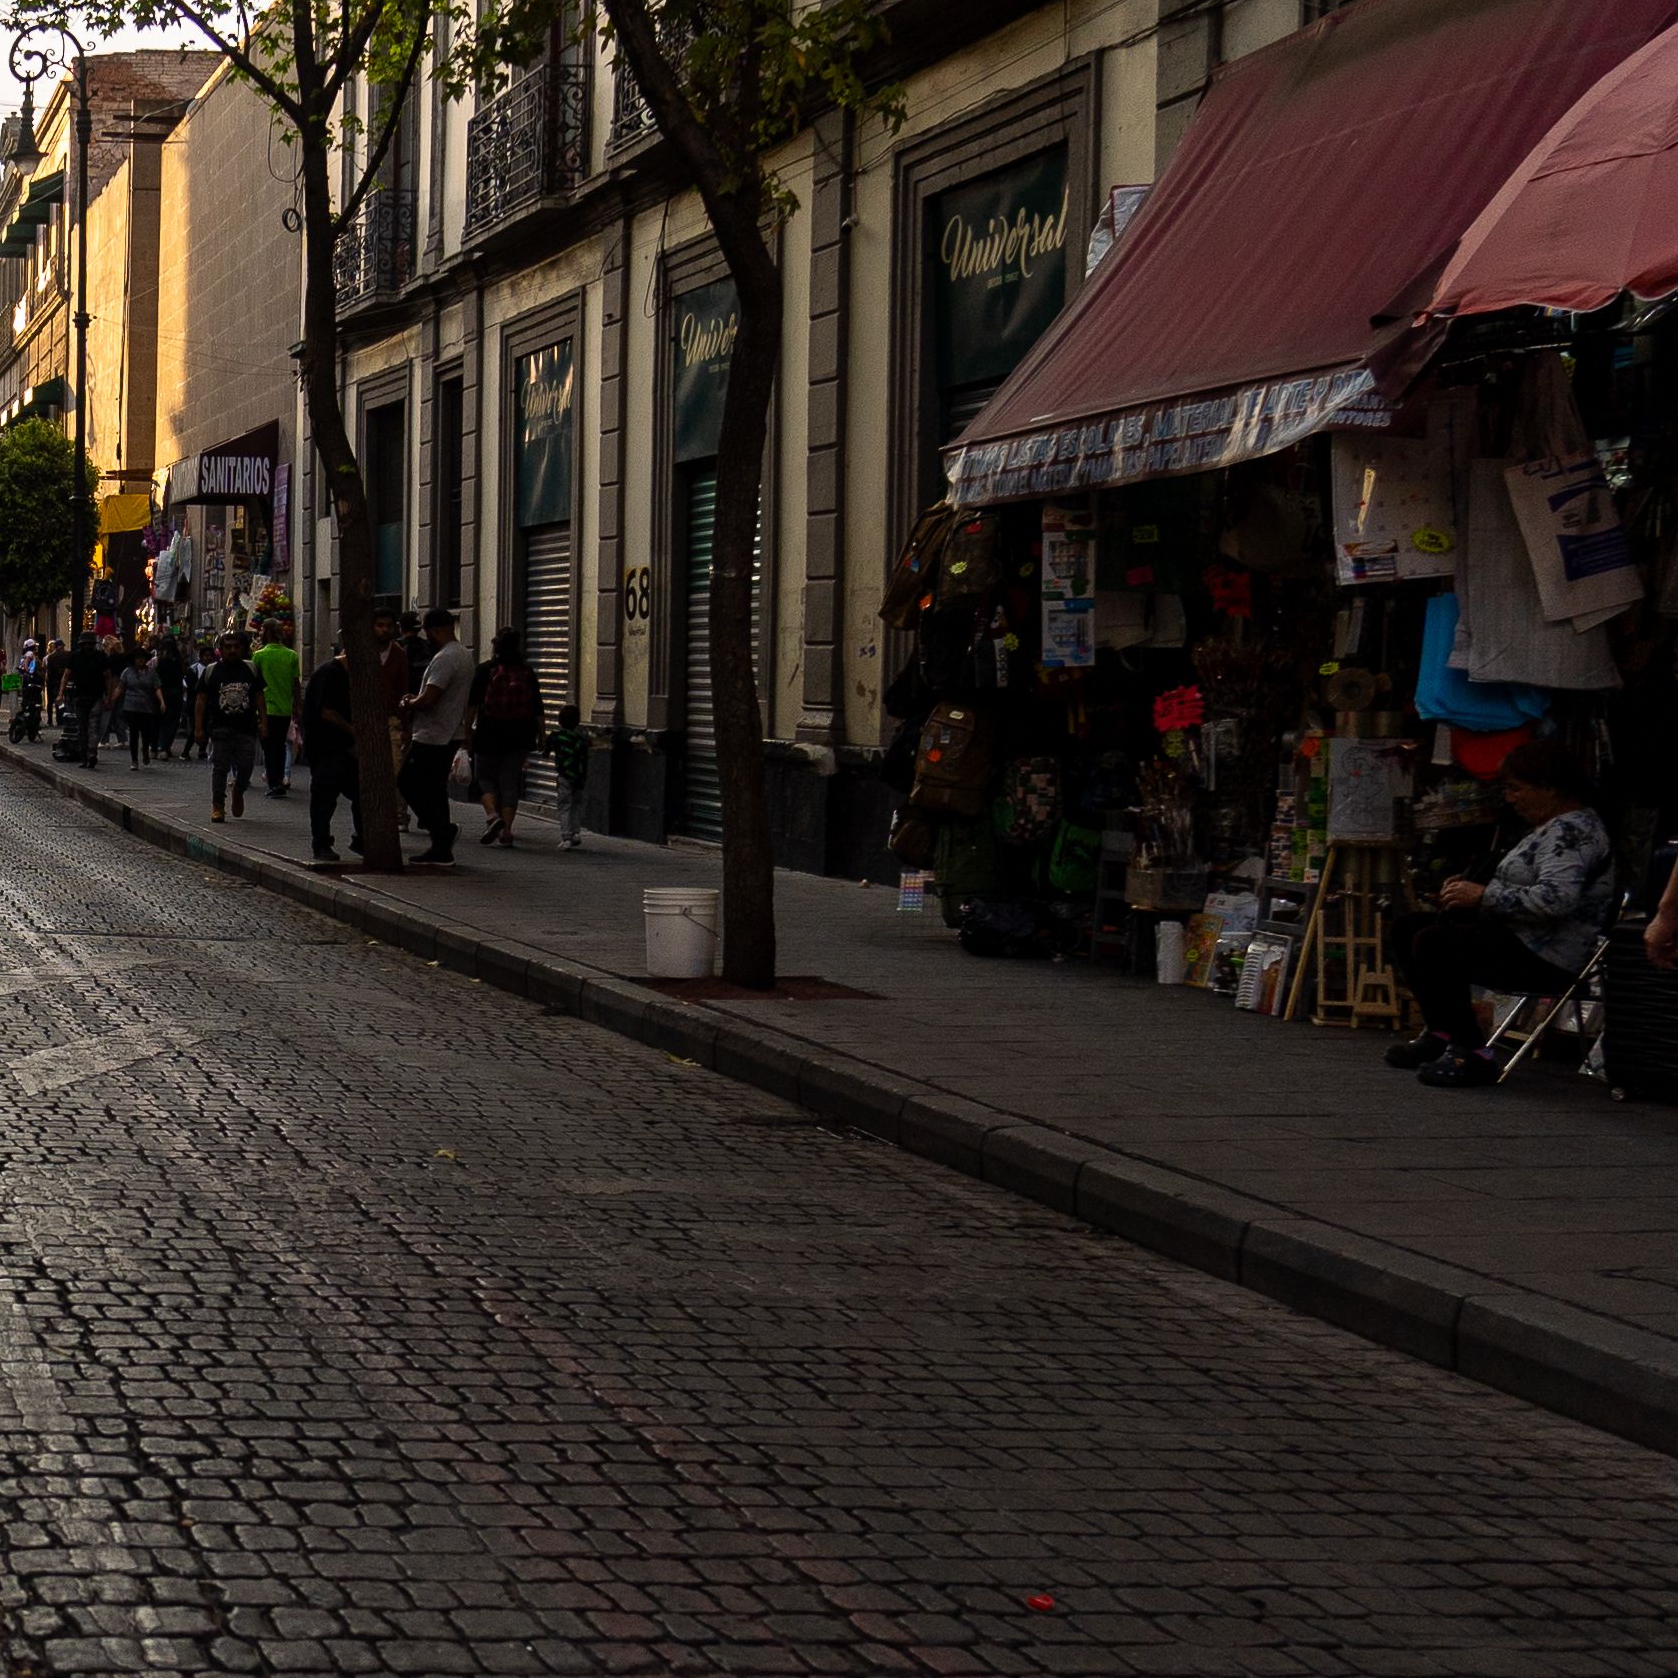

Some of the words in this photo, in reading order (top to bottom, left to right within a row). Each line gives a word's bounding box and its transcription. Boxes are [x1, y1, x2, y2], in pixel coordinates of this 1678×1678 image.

[941, 182, 1069, 282] Universal
[681, 312, 738, 367] Univer
[201, 455, 270, 495] SANITARIOS
[626, 567, 650, 620] 68
